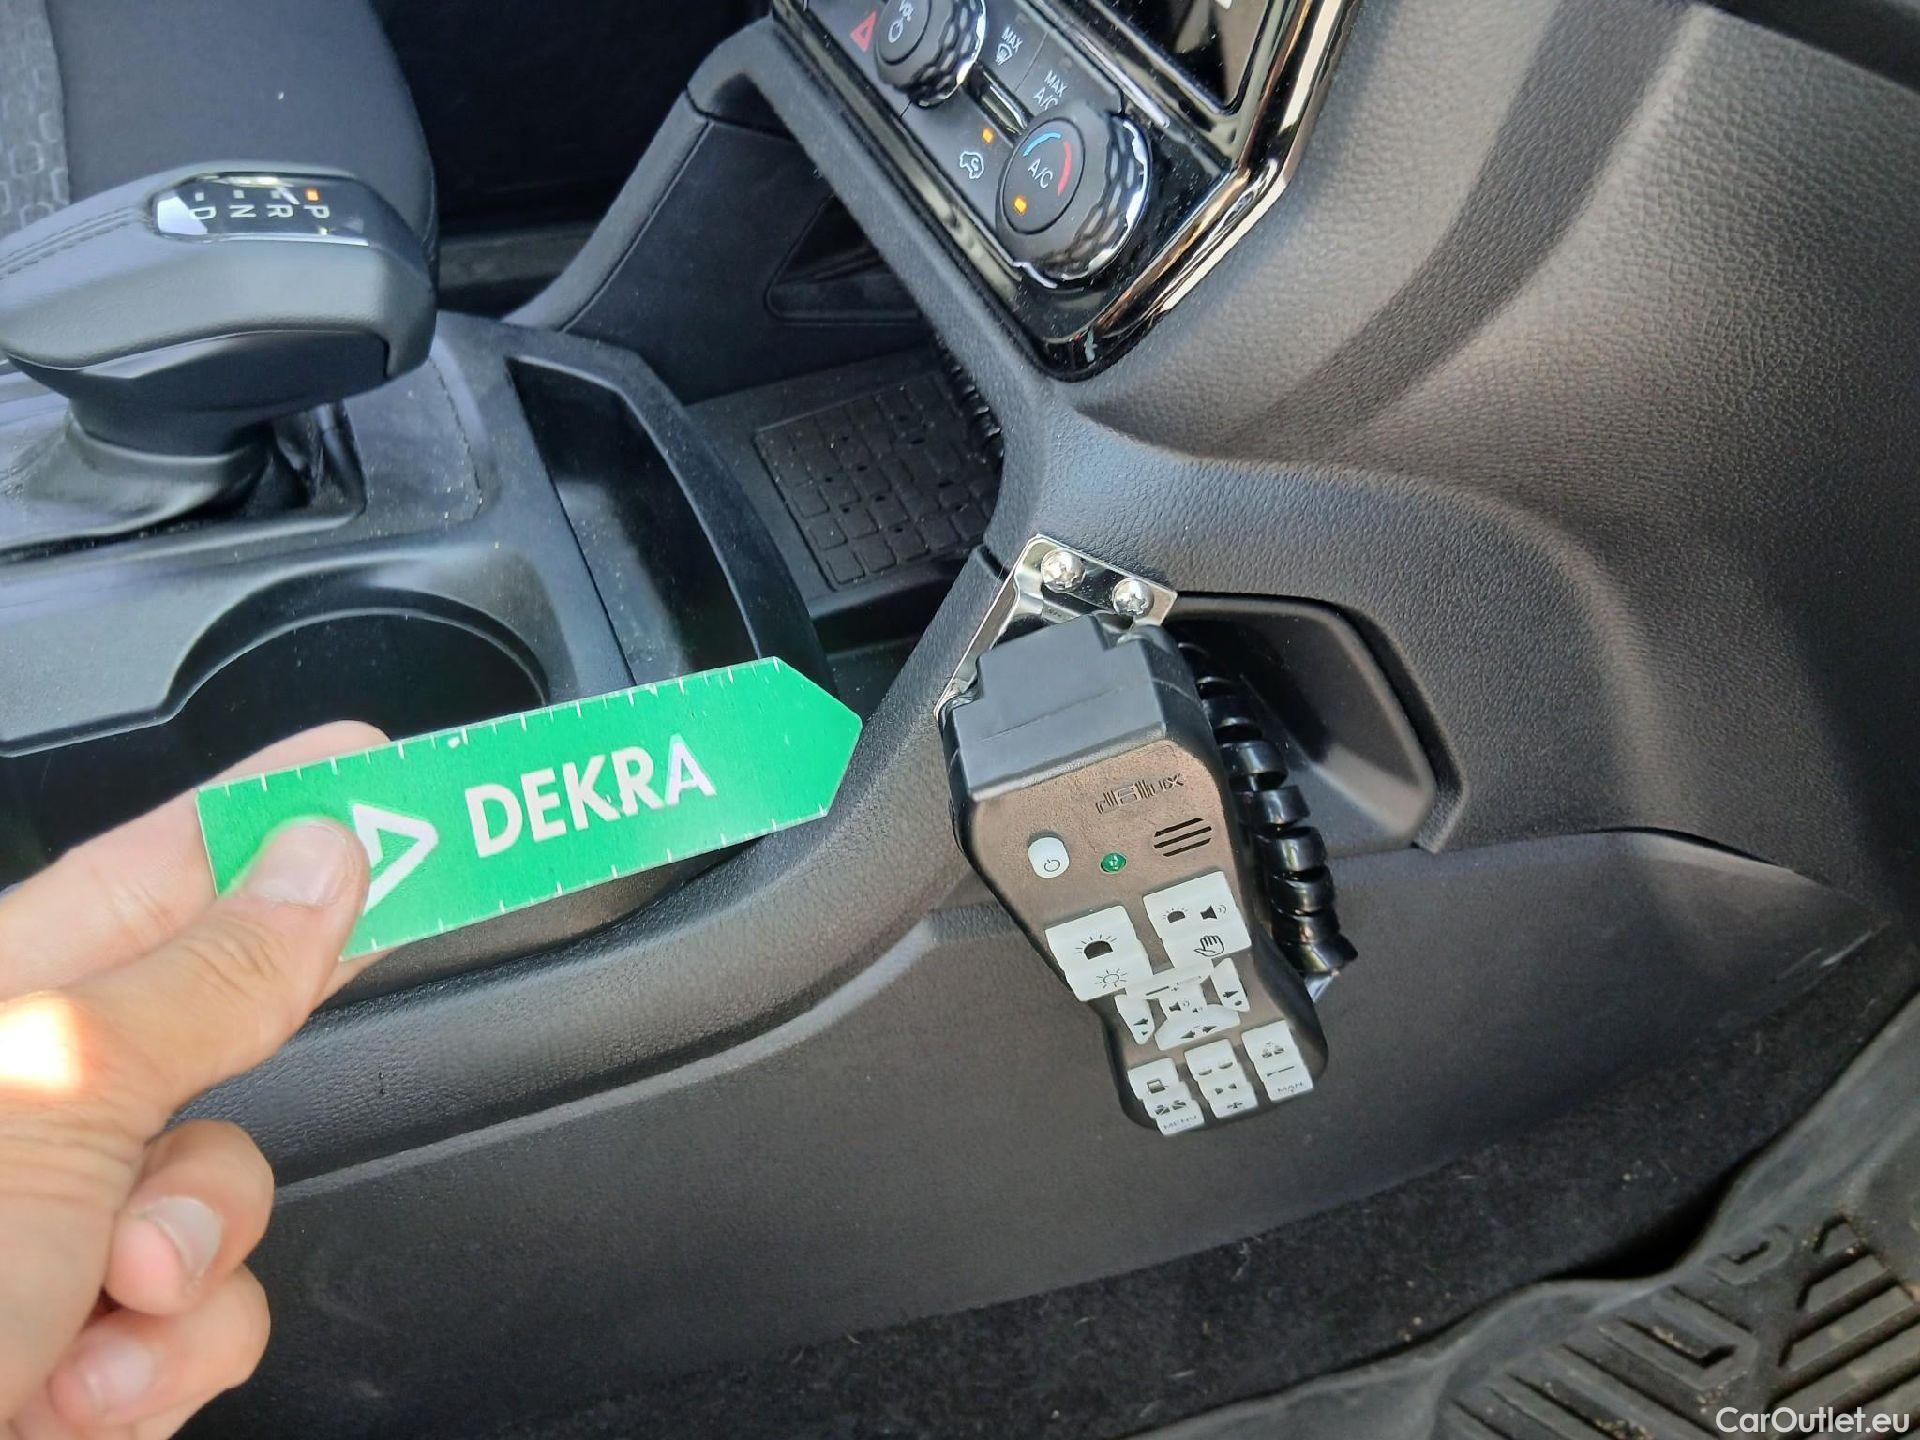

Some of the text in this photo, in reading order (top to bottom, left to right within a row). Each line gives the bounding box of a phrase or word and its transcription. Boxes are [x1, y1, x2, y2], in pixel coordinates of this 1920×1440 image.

[1002, 26, 1023, 54] MAX
[1044, 69, 1068, 98] MAX
[1027, 158, 1053, 189] A/C
[229, 204, 257, 219] N
[266, 204, 294, 219] R
[303, 204, 331, 219] P
[464, 733, 717, 859] DEKRA
